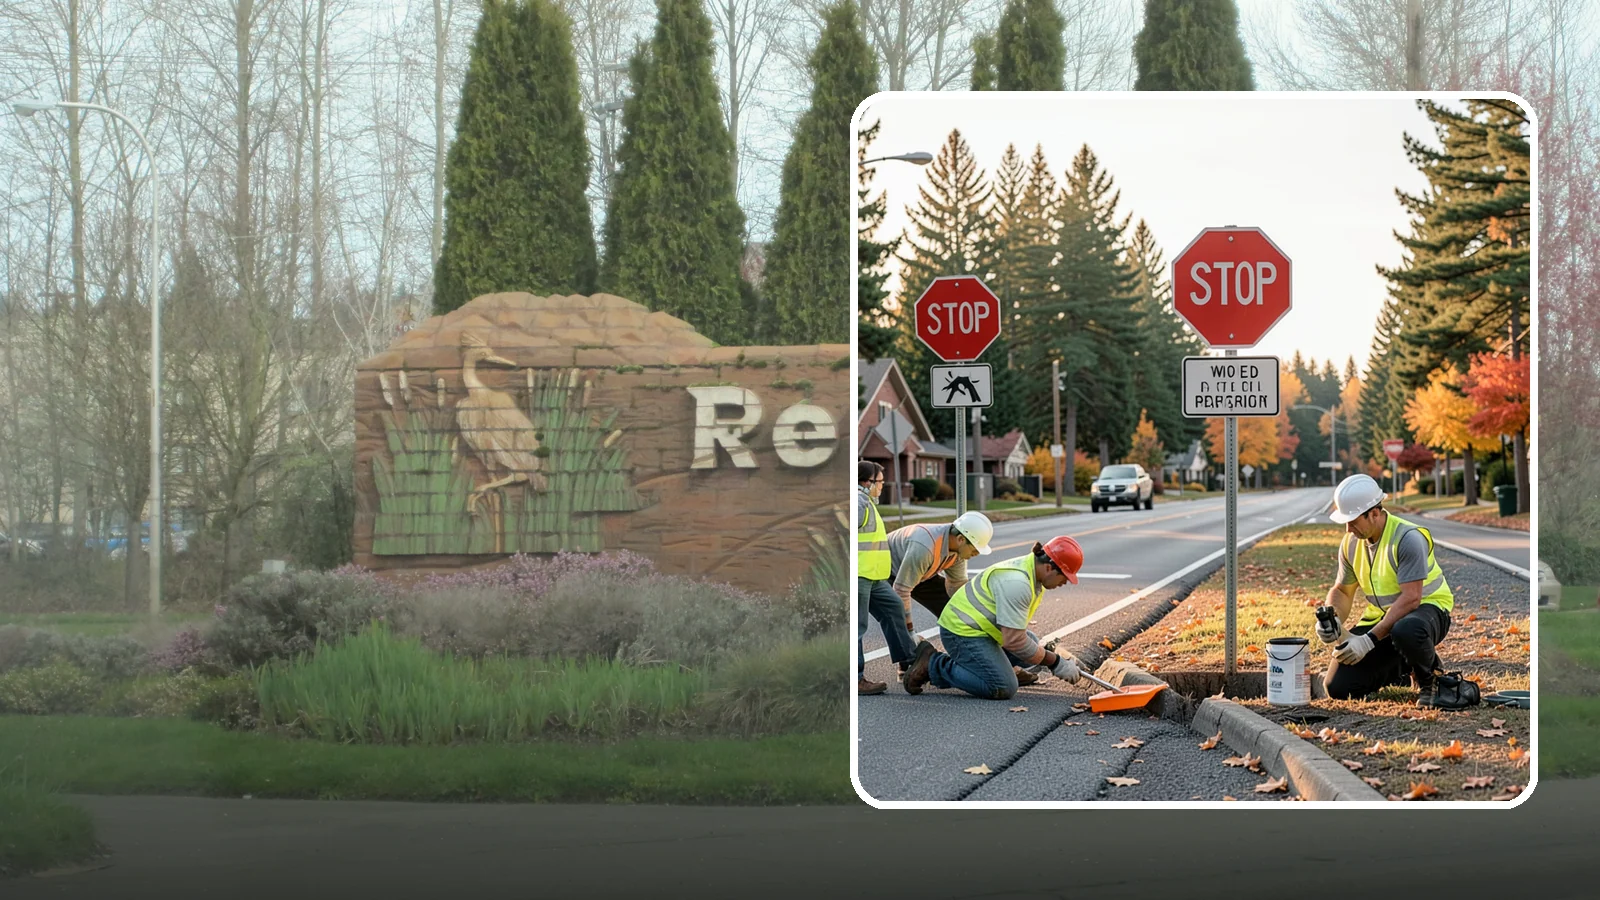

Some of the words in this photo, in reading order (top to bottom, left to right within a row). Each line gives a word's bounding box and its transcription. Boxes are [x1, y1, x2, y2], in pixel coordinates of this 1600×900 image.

[1190, 261, 1277, 305] STOP
[927, 301, 990, 335] STOP
[686, 386, 837, 469] Re
